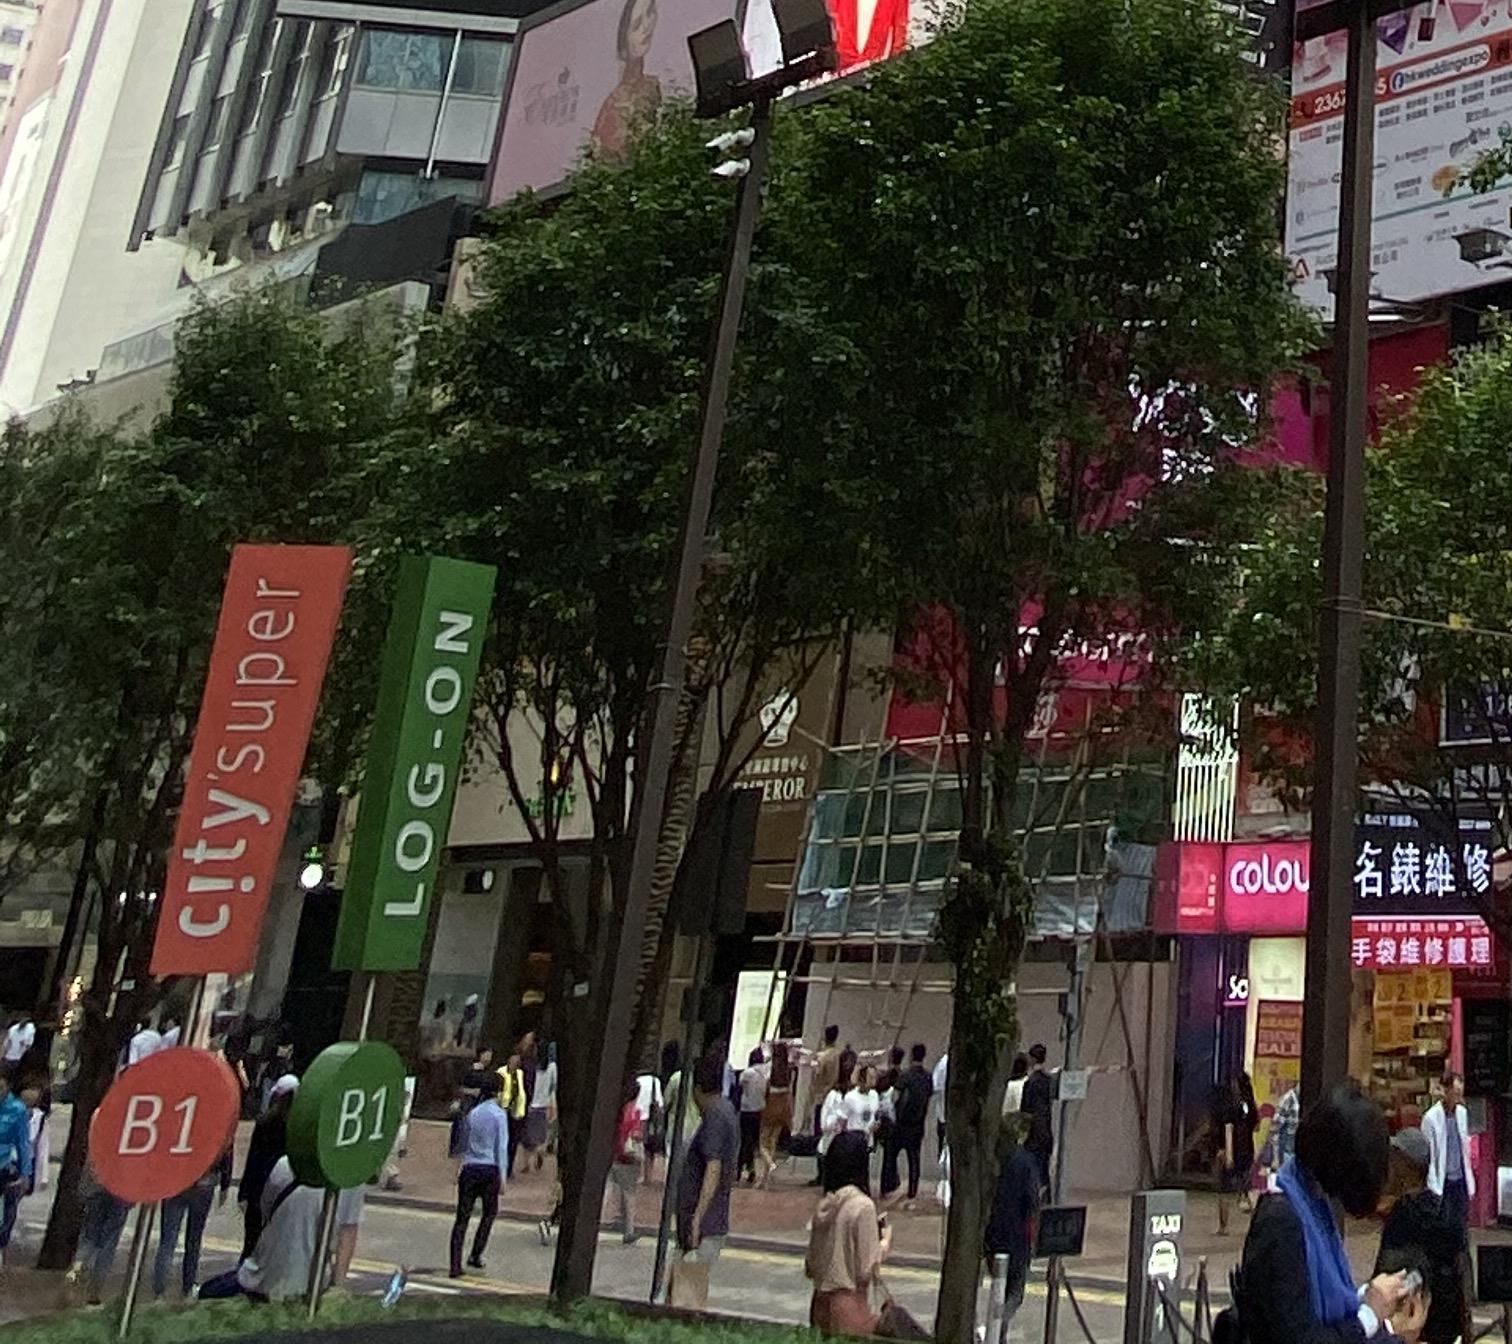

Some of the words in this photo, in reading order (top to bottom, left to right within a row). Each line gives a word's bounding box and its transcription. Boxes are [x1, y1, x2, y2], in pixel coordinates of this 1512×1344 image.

[178, 576, 301, 939] city'super
[383, 610, 475, 918] LOG-ON
[1353, 840, 1491, 898] 名錶維修
[116, 1094, 199, 1155] B1
[335, 1085, 389, 1148] B1
[1151, 1214, 1181, 1234] TAXI
